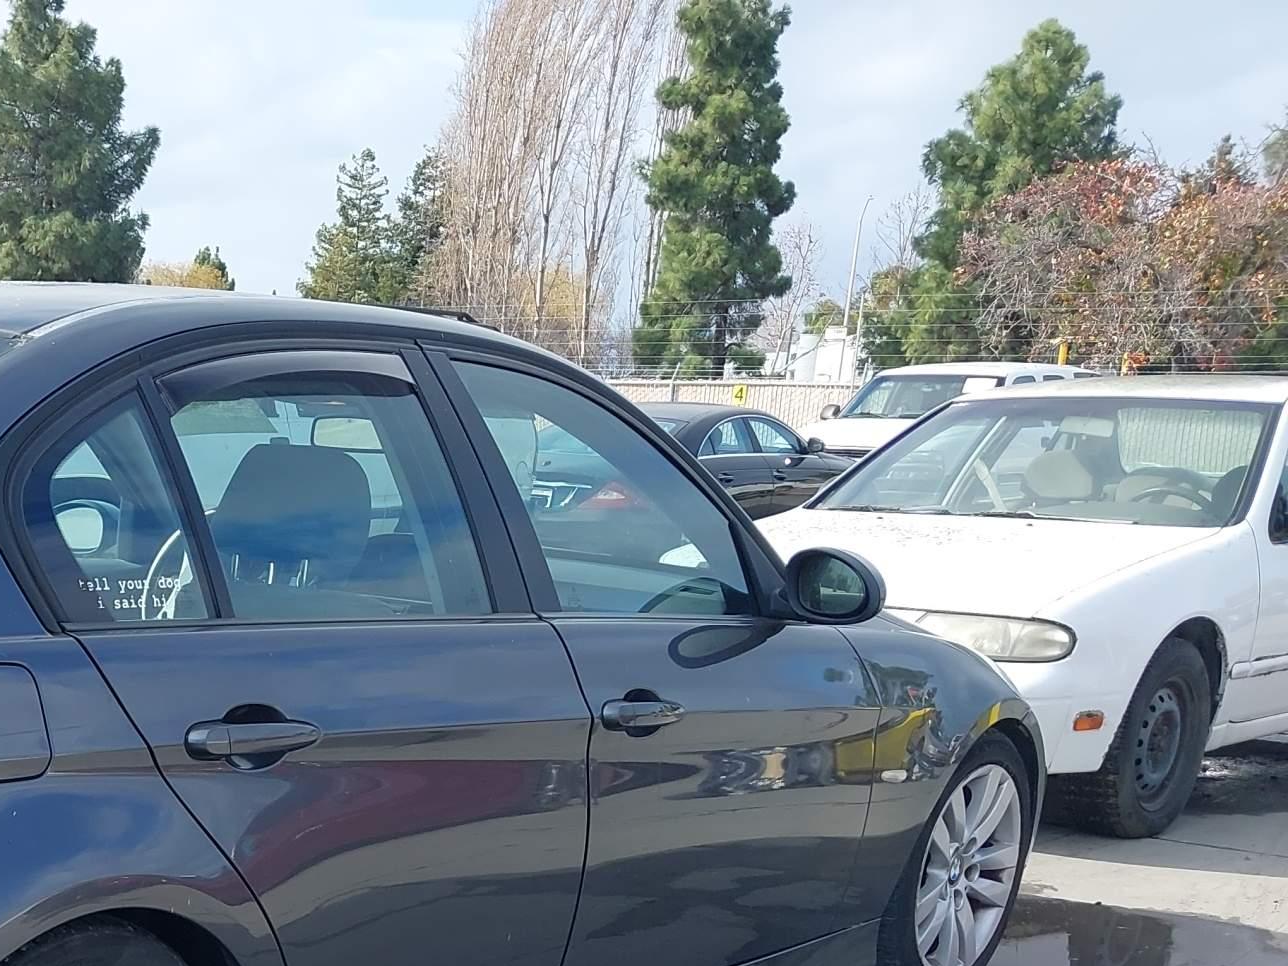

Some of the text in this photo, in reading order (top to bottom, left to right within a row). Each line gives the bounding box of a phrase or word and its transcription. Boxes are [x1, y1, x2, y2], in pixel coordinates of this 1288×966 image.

[734, 386, 744, 402] 4
[78, 576, 182, 594] tell your dog
[97, 596, 105, 609] i
[114, 594, 146, 609] said
